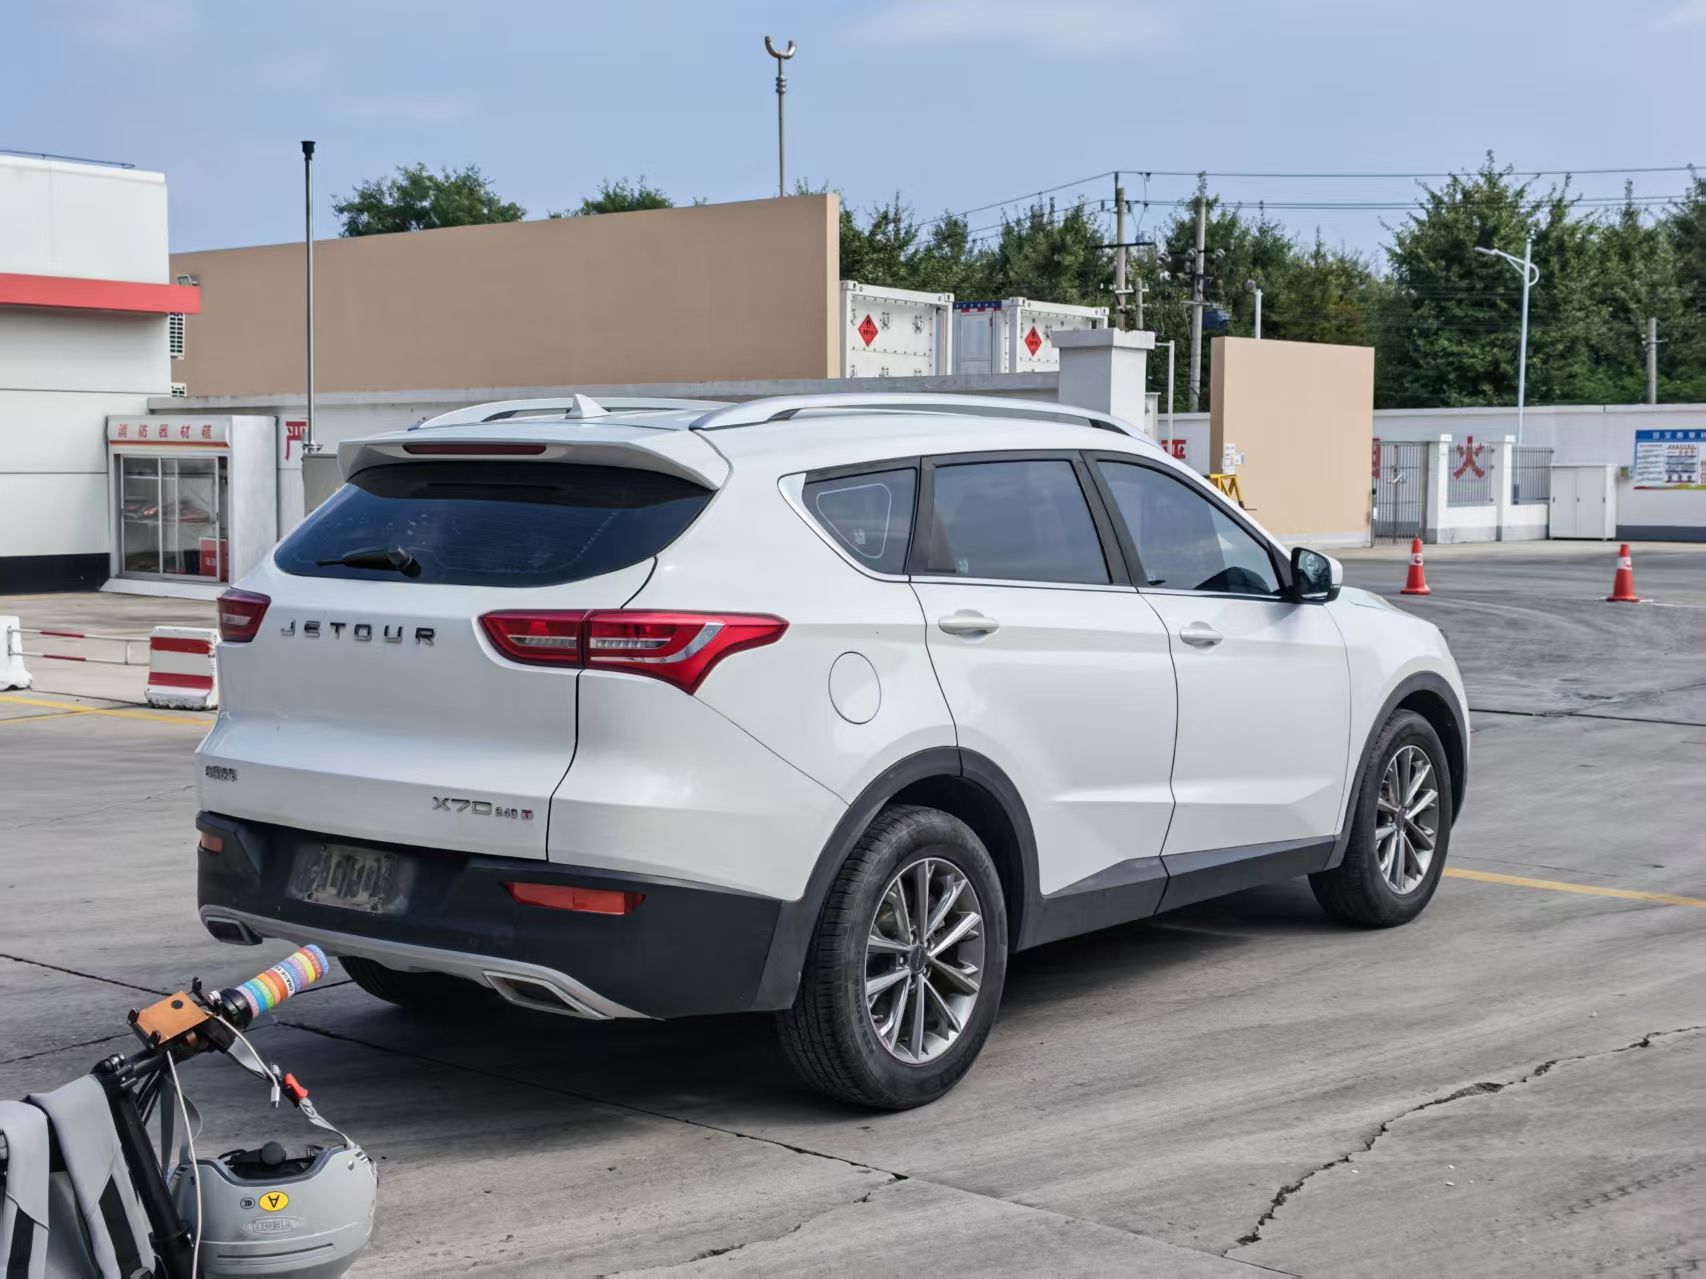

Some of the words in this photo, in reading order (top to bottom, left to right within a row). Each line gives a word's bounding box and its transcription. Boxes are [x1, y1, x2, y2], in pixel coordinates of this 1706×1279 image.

[1453, 435, 1486, 480] 火
[280, 620, 437, 646] JETOUR
[432, 796, 493, 816] X70
[267, 1195, 281, 1209] A
